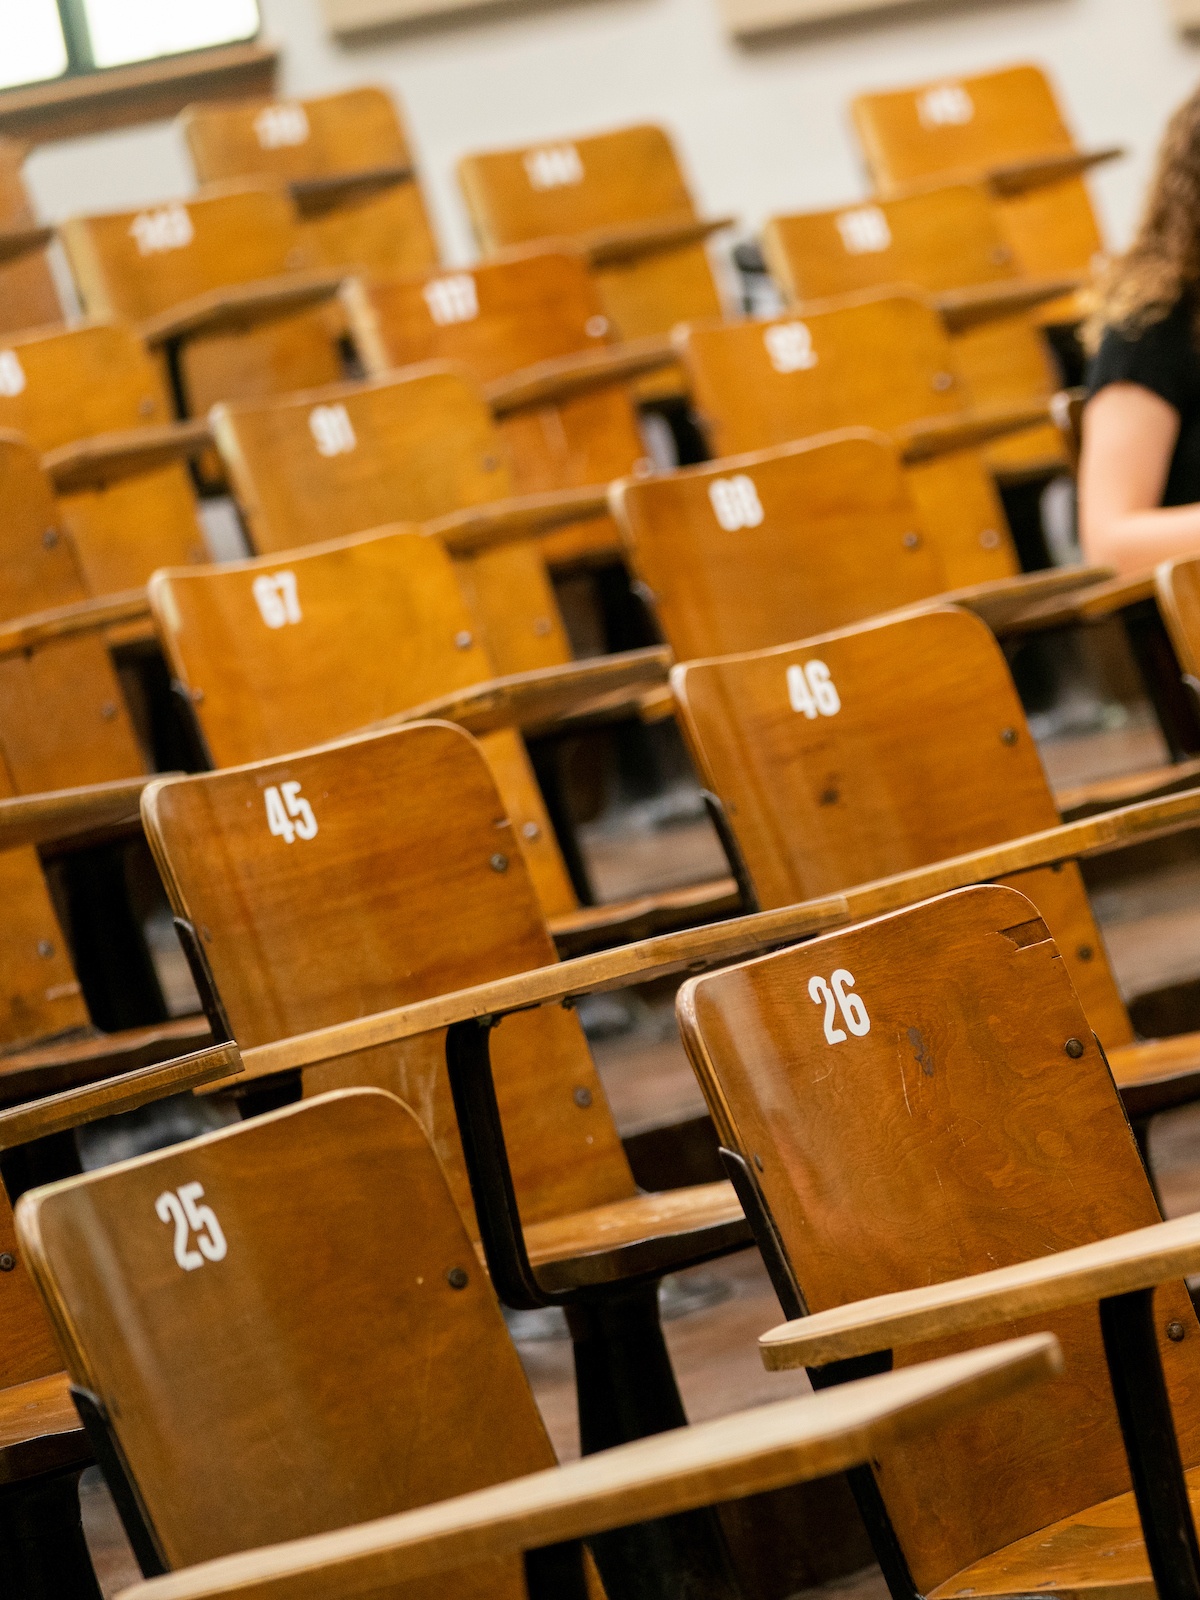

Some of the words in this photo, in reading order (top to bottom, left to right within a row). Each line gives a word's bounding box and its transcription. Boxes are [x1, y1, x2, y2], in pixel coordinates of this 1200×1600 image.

[253, 571, 301, 628] 67
[787, 660, 841, 719] 46
[264, 781, 318, 843] 45
[807, 968, 871, 1045] 26
[156, 1182, 227, 1270] 25
